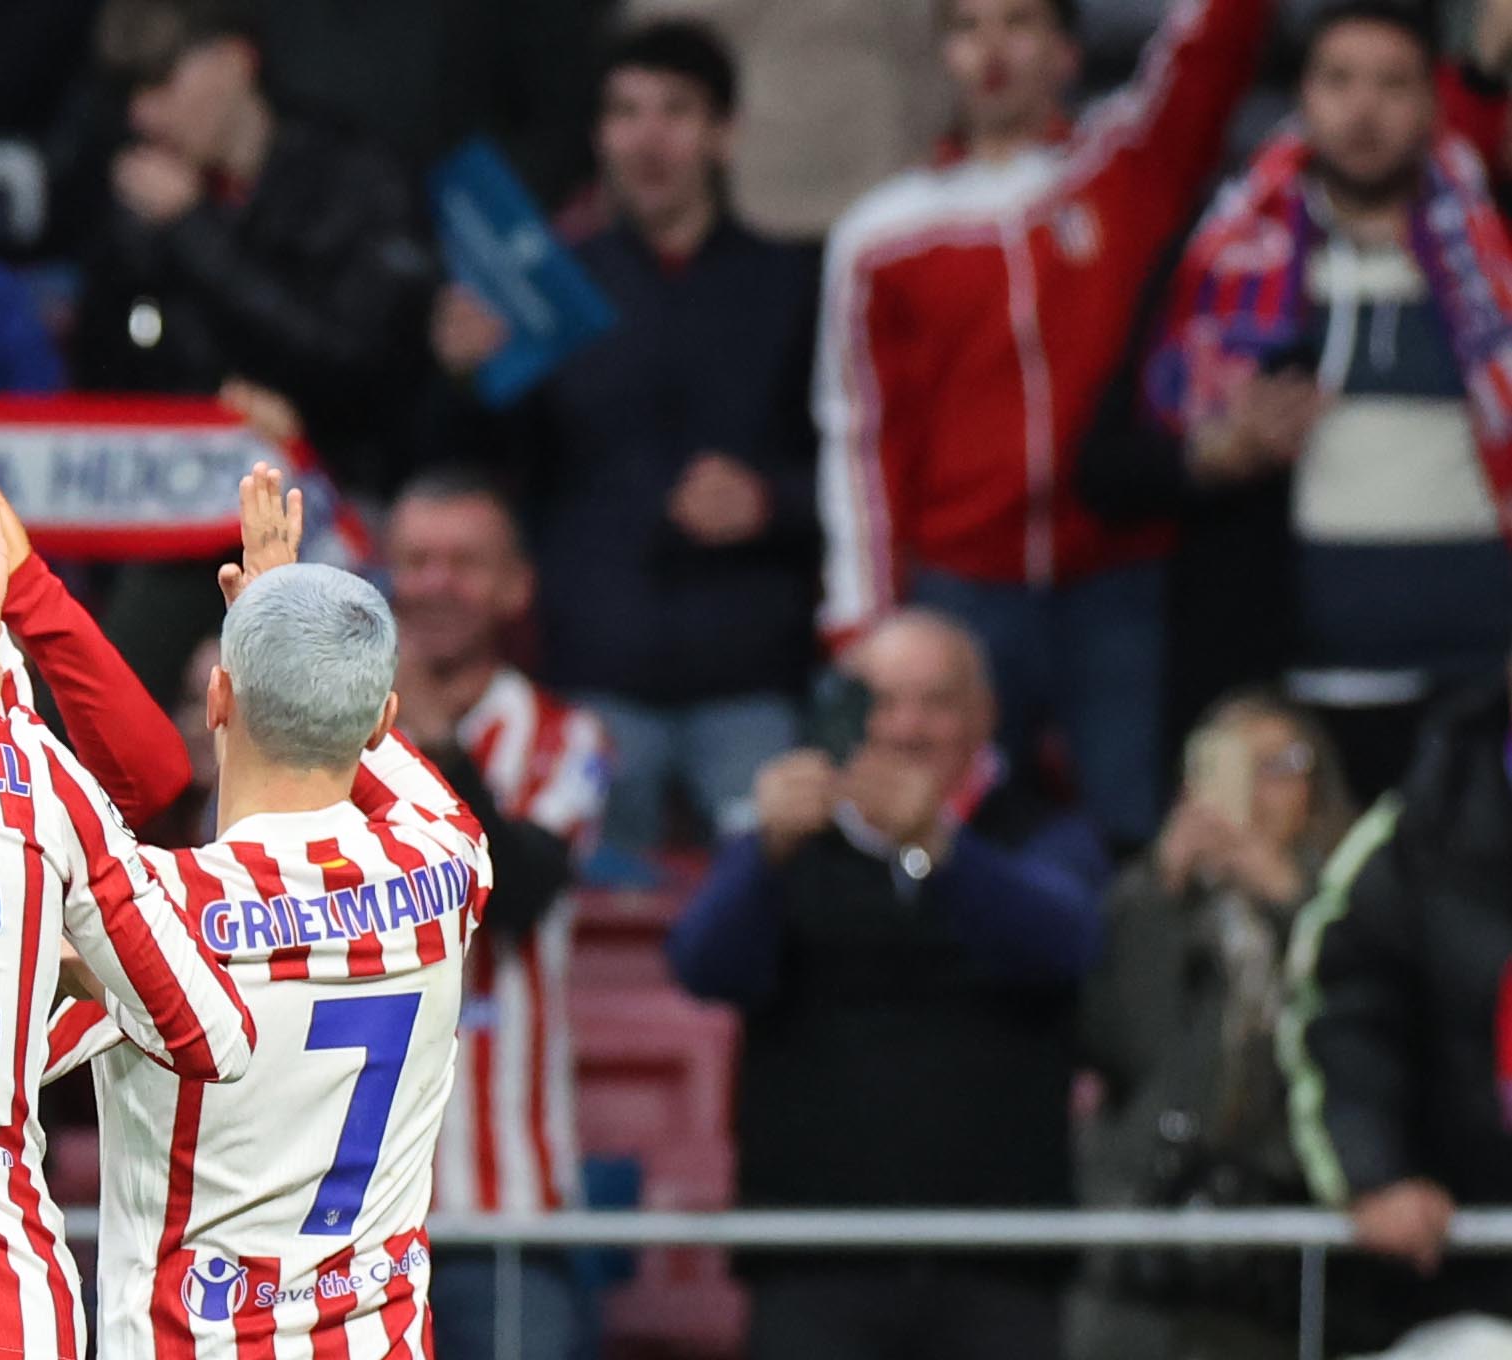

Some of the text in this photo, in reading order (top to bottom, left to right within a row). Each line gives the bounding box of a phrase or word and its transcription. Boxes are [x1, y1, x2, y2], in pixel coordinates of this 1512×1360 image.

[201, 857, 470, 952] GRIEZMANN
[299, 992, 423, 1236] 7
[257, 1284, 315, 1306] Save
[320, 1270, 363, 1298] the
